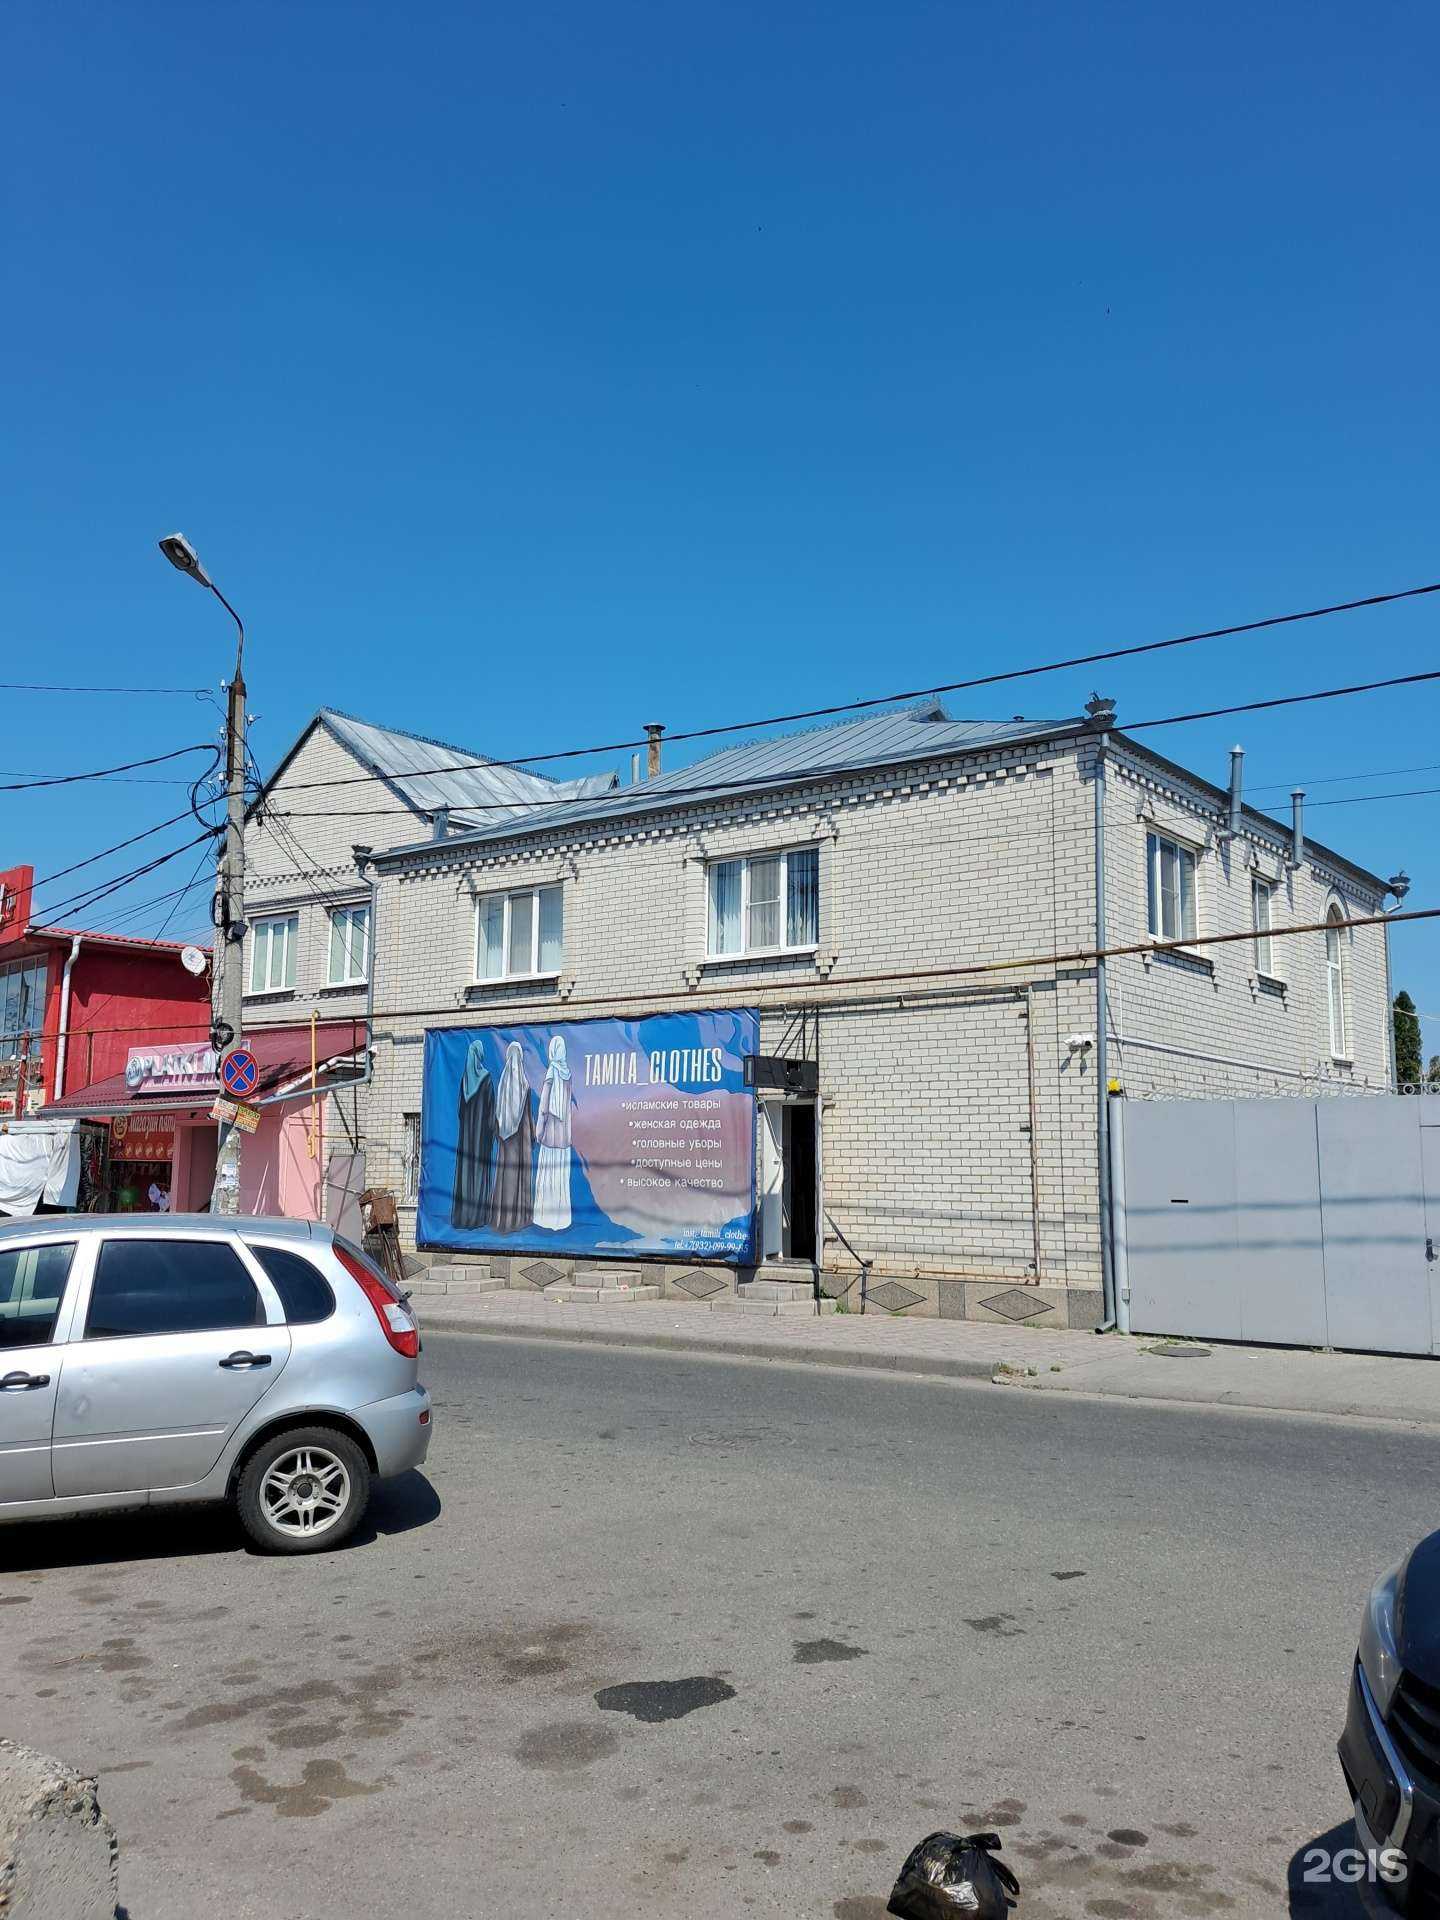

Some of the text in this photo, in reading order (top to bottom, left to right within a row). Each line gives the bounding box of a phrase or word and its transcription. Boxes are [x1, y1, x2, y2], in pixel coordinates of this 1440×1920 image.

[585, 1047, 722, 1086] TAMILA_CLOTHES
[683, 1099, 721, 1111] товары
[633, 1119, 721, 1130] женская одежда
[636, 1139, 722, 1151] головные уборы
[635, 1159, 723, 1170] доступные цены
[627, 1178, 724, 1188] высокое качество
